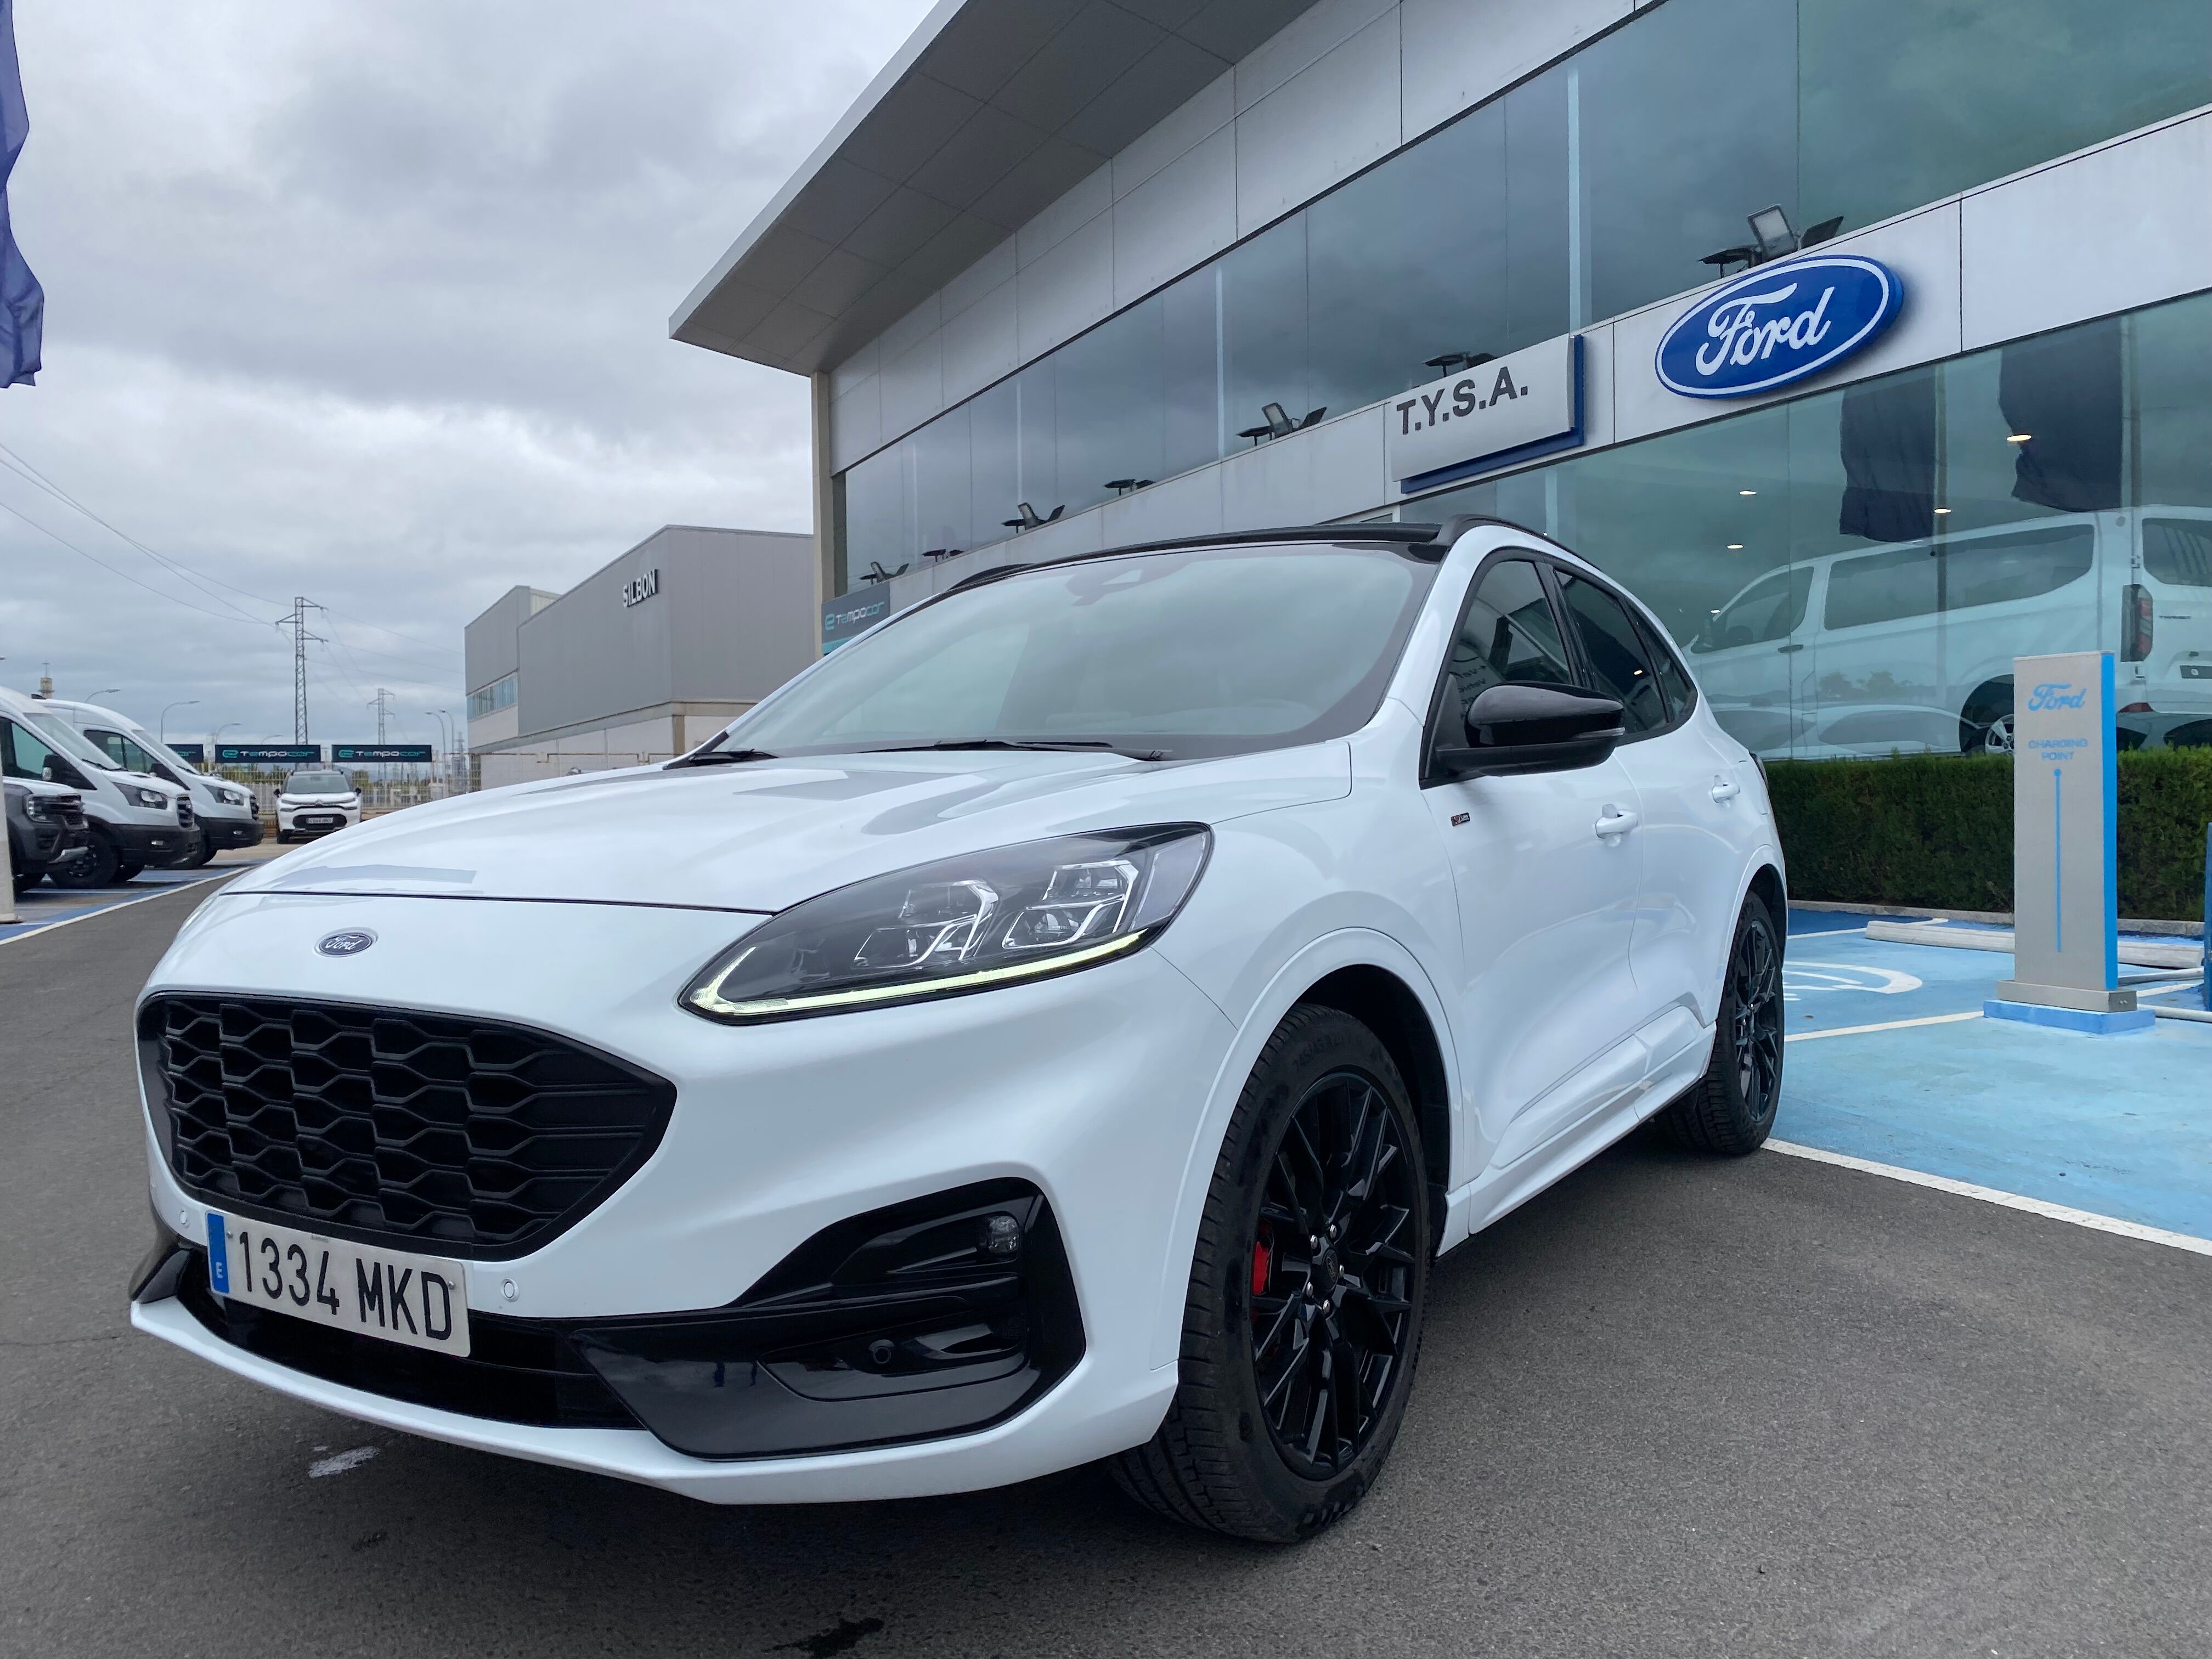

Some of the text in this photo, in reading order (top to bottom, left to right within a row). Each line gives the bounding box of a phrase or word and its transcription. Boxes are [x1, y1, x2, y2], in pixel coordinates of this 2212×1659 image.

[1696, 283, 1835, 376] Ford
[1396, 366, 1528, 435] T.Y.S.A.
[623, 569, 657, 608] SILBON
[2028, 682, 2087, 712] Ford
[2028, 738, 2089, 749] CHARGING
[2041, 752, 2074, 760] POINT
[325, 934, 363, 950] Ford
[215, 1261, 224, 1279] E
[239, 1232, 452, 1340] 1334 MKD
